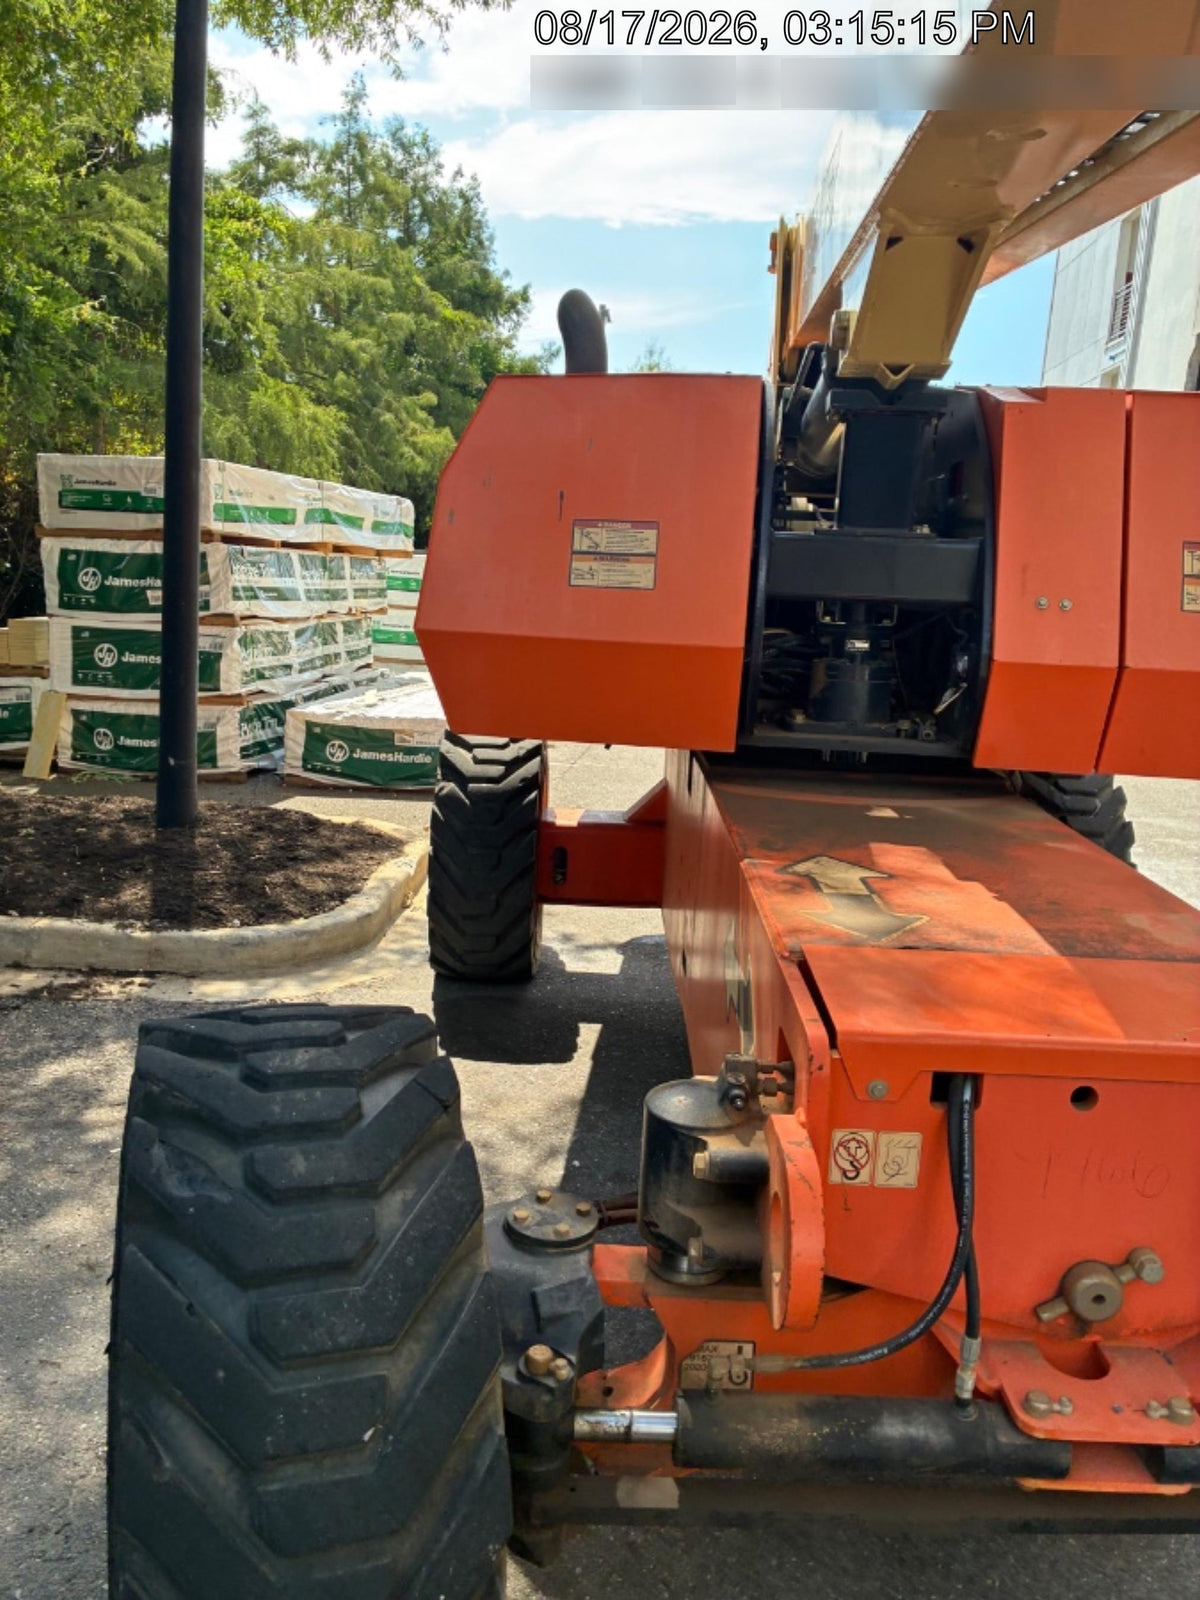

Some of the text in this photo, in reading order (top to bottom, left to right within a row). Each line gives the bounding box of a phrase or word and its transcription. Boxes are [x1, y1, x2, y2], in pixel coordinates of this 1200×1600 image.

[104, 575, 162, 587] JamesHa
[121, 651, 162, 664] James
[116, 735, 160, 748] James
[352, 748, 433, 764] JamesHardie
